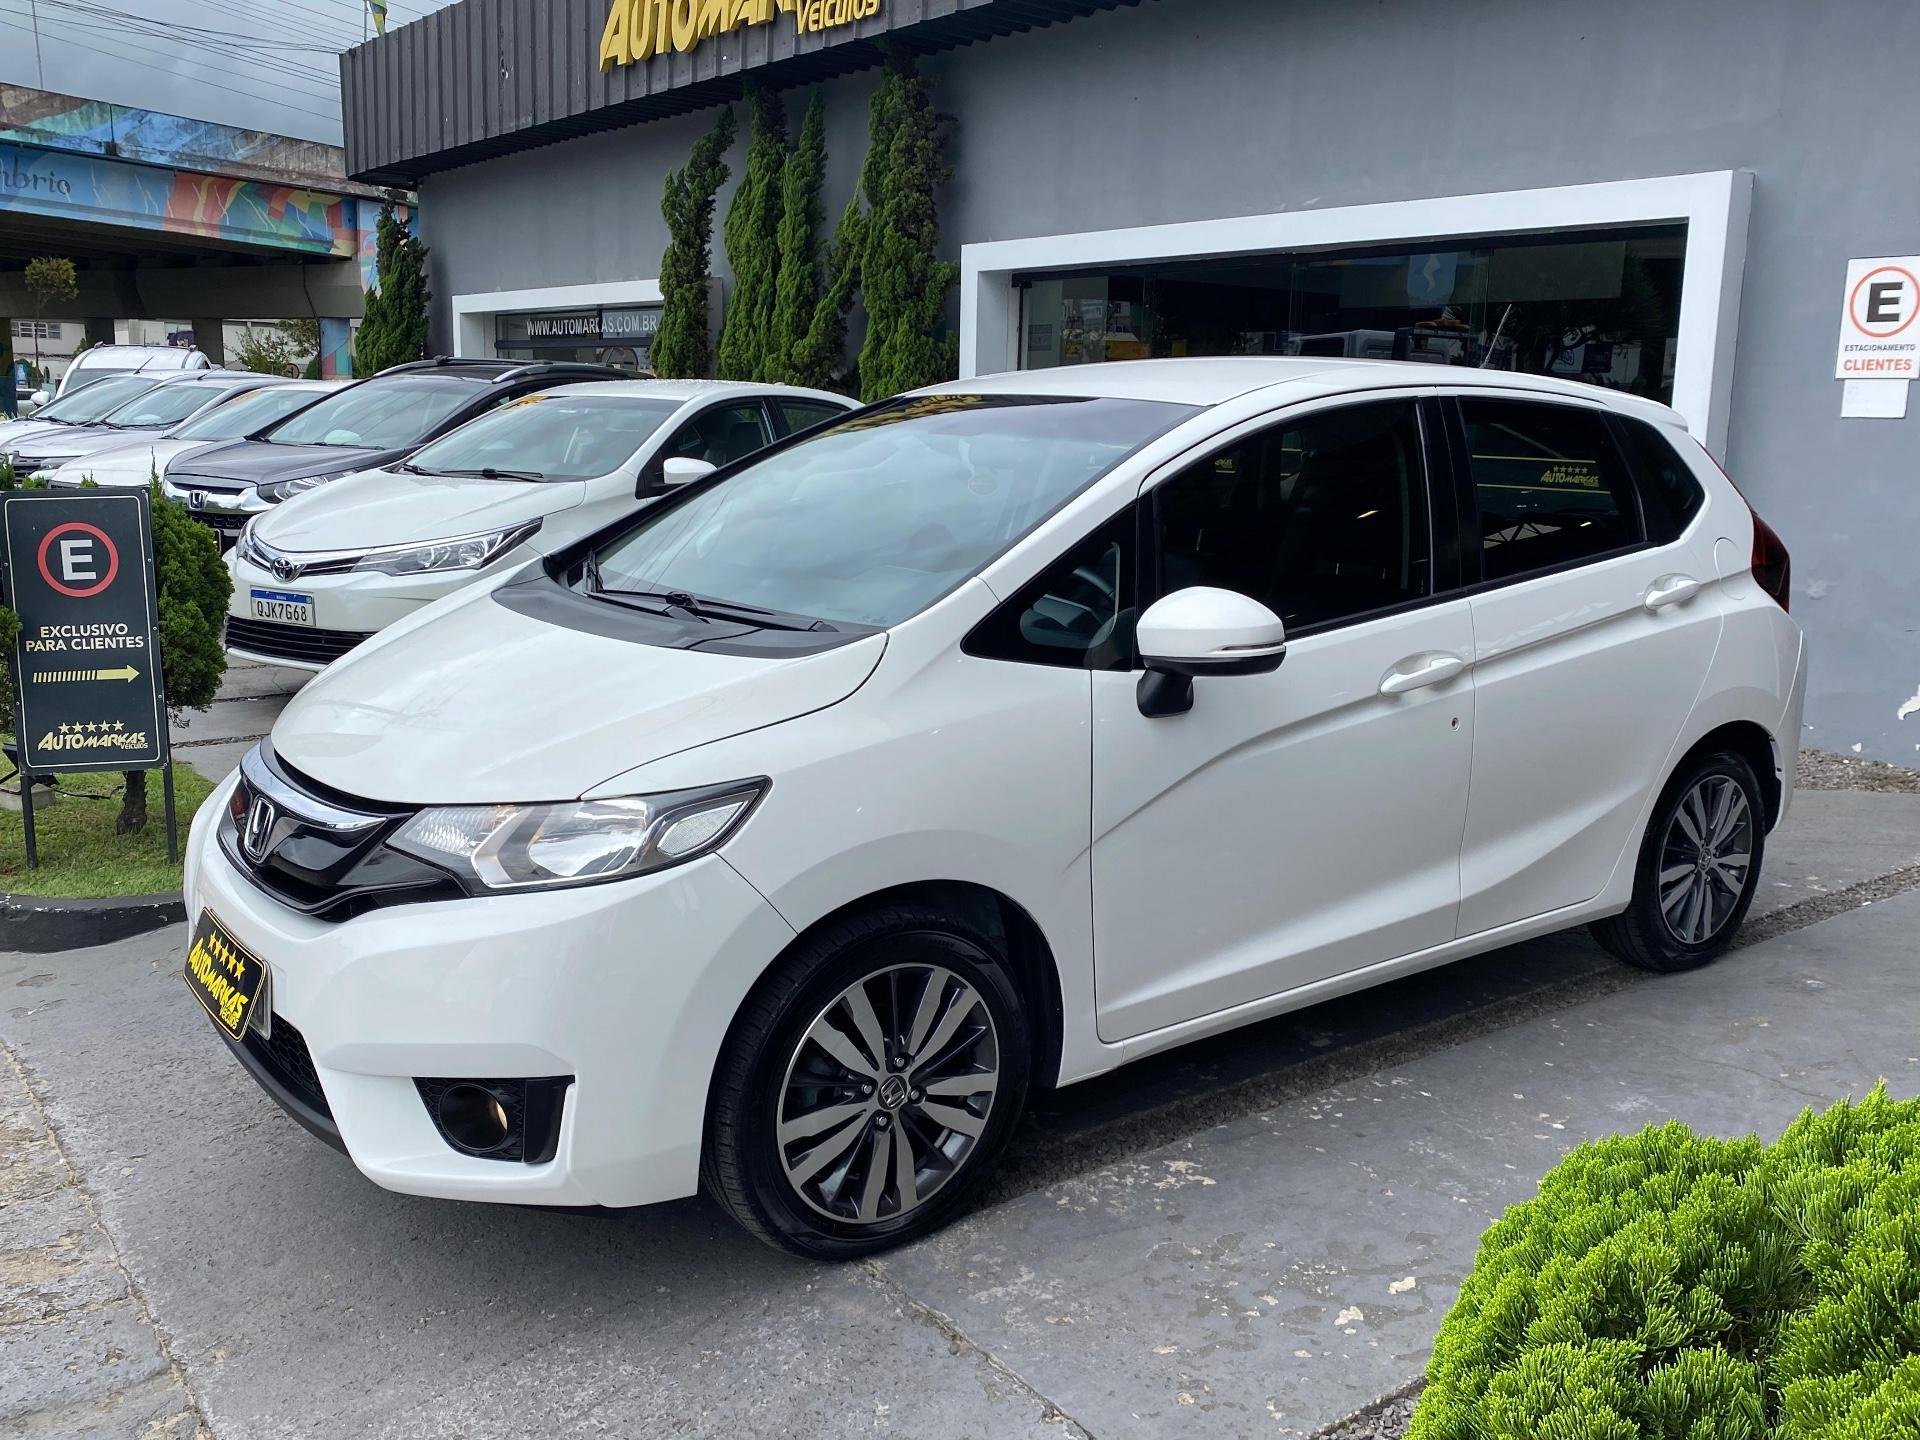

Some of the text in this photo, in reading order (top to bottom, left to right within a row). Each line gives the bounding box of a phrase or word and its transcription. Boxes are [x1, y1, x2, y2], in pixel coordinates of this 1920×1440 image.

[1866, 281, 1904, 323] E
[526, 314, 657, 336] WWW.AUTOMARKAS.COM.BR
[1844, 343, 1916, 352] ESTACIONAMENTO
[1843, 358, 1913, 371] CLIENTES
[60, 539, 97, 580] E
[257, 600, 307, 622] QJK7G68
[40, 623, 128, 638] EXCLUSIVO
[26, 636, 144, 652] PARA CLIENTES
[37, 731, 146, 751] AUTOMARKAS
